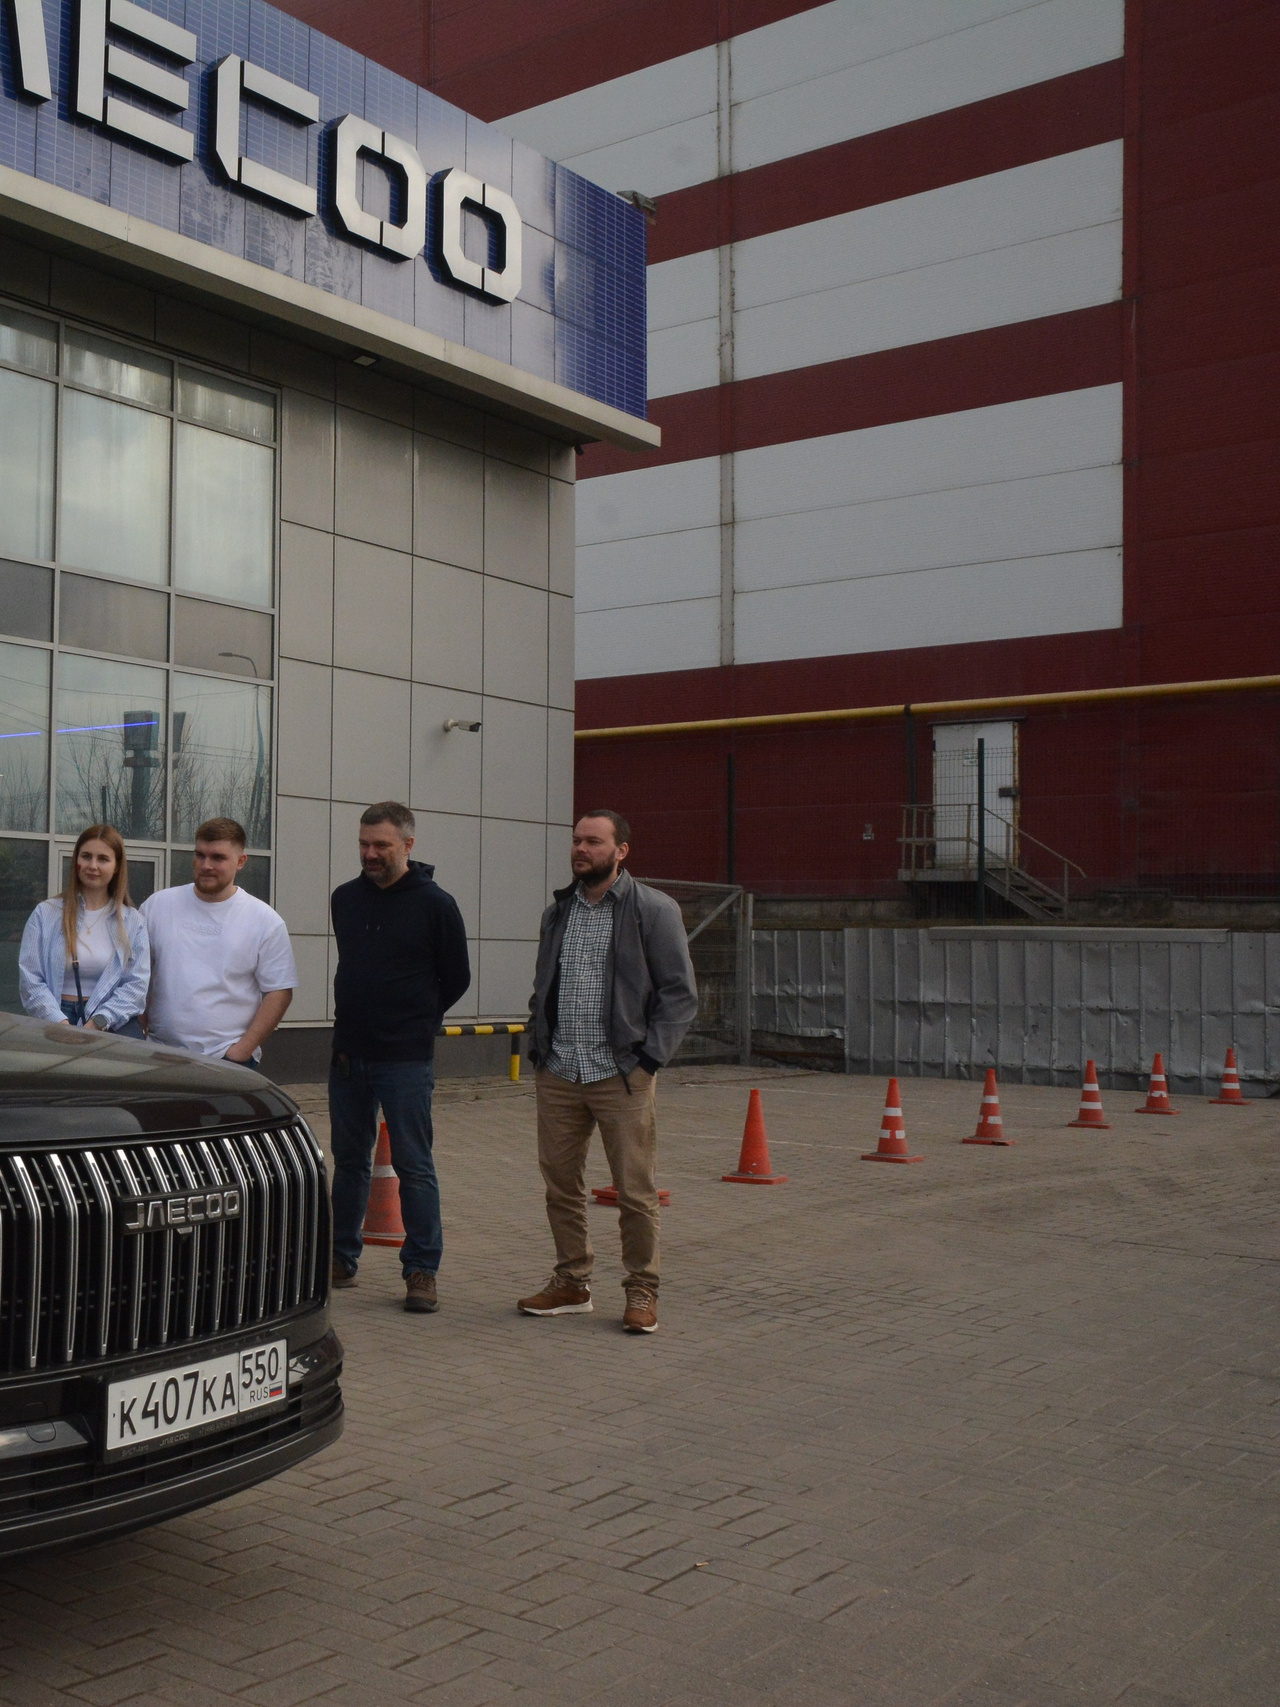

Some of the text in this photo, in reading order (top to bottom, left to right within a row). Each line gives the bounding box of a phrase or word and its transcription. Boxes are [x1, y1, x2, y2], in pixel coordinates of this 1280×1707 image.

[126, 1190, 240, 1229] JAECOO
[241, 1346, 279, 1389] 550
[249, 1386, 269, 1403] RUS
